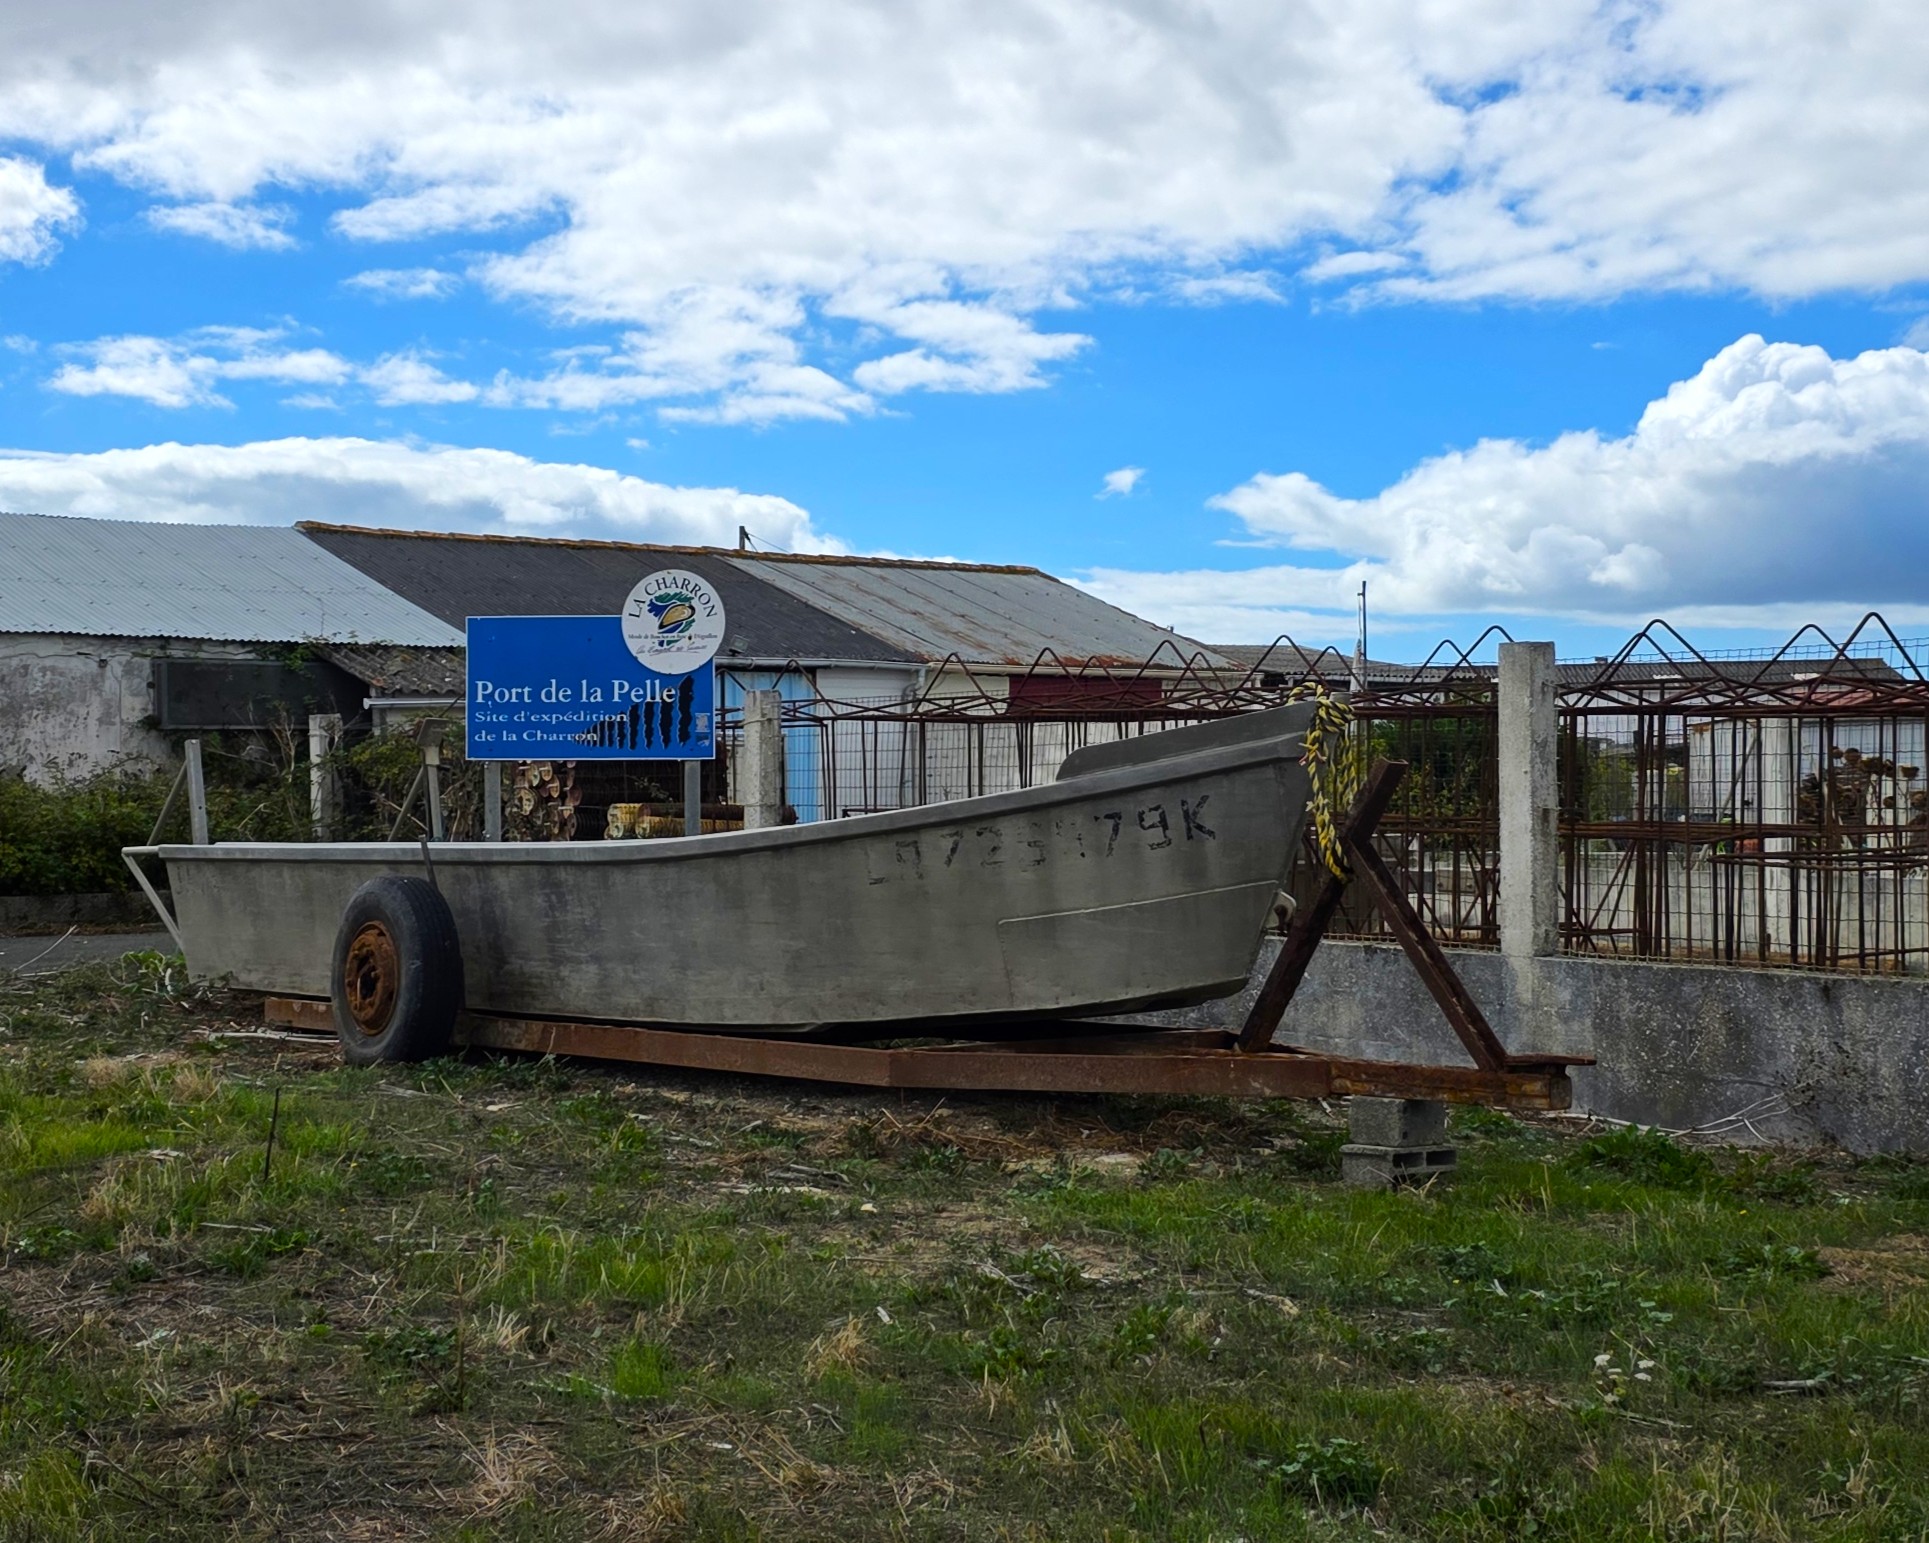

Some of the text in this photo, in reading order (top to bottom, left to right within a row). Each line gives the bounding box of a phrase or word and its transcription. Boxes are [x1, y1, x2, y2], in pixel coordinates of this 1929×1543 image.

[628, 576, 718, 618] LA CHARRON
[474, 679, 676, 703] Port de la Pelle
[474, 710, 627, 725] Site d'expédition
[474, 730, 598, 742] de la Charron
